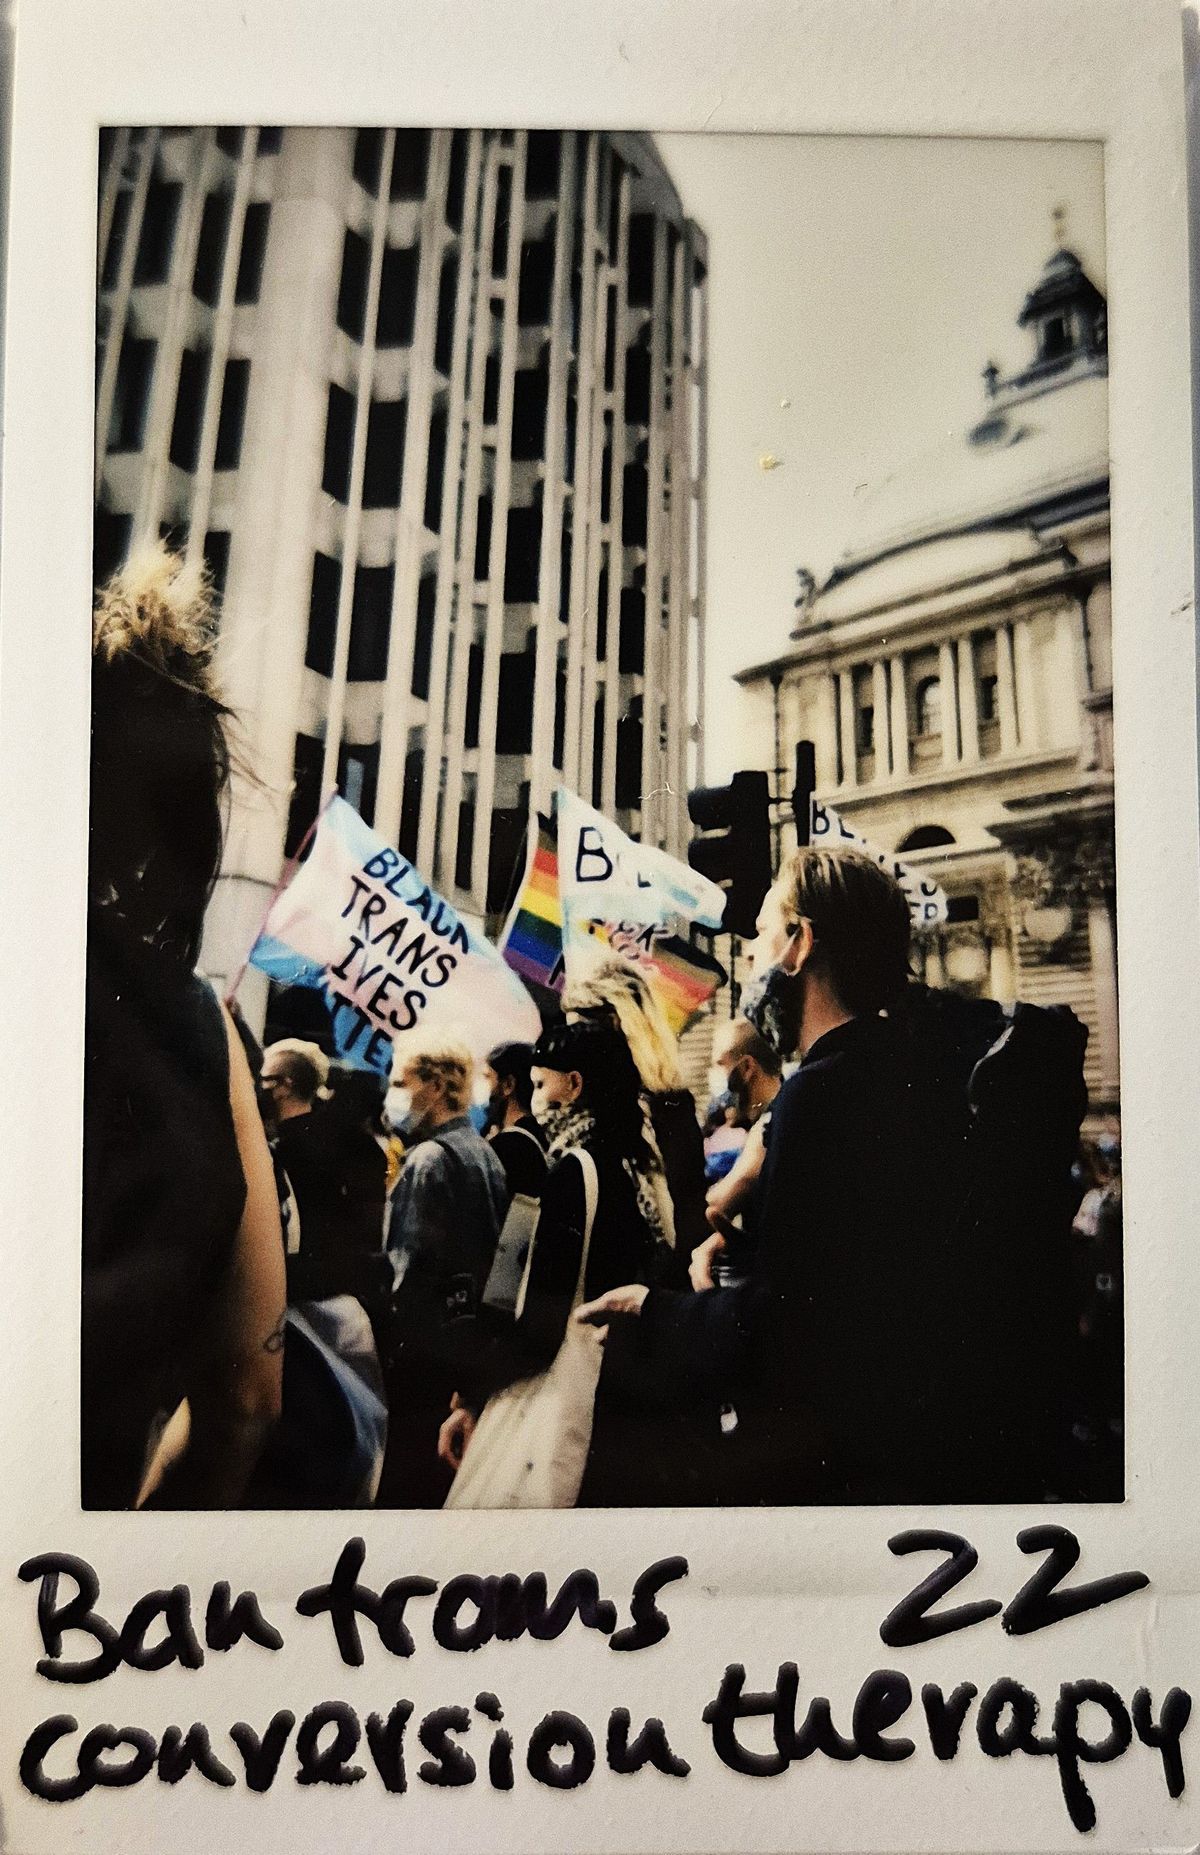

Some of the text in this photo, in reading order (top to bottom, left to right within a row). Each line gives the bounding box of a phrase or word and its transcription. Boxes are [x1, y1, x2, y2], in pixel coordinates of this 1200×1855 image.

[330, 935, 427, 1031] IVES
[340, 874, 458, 988] TRANS
[17, 1524, 1151, 1685] Ban trans 22
[18, 1660, 1193, 1834] conversion therapy
